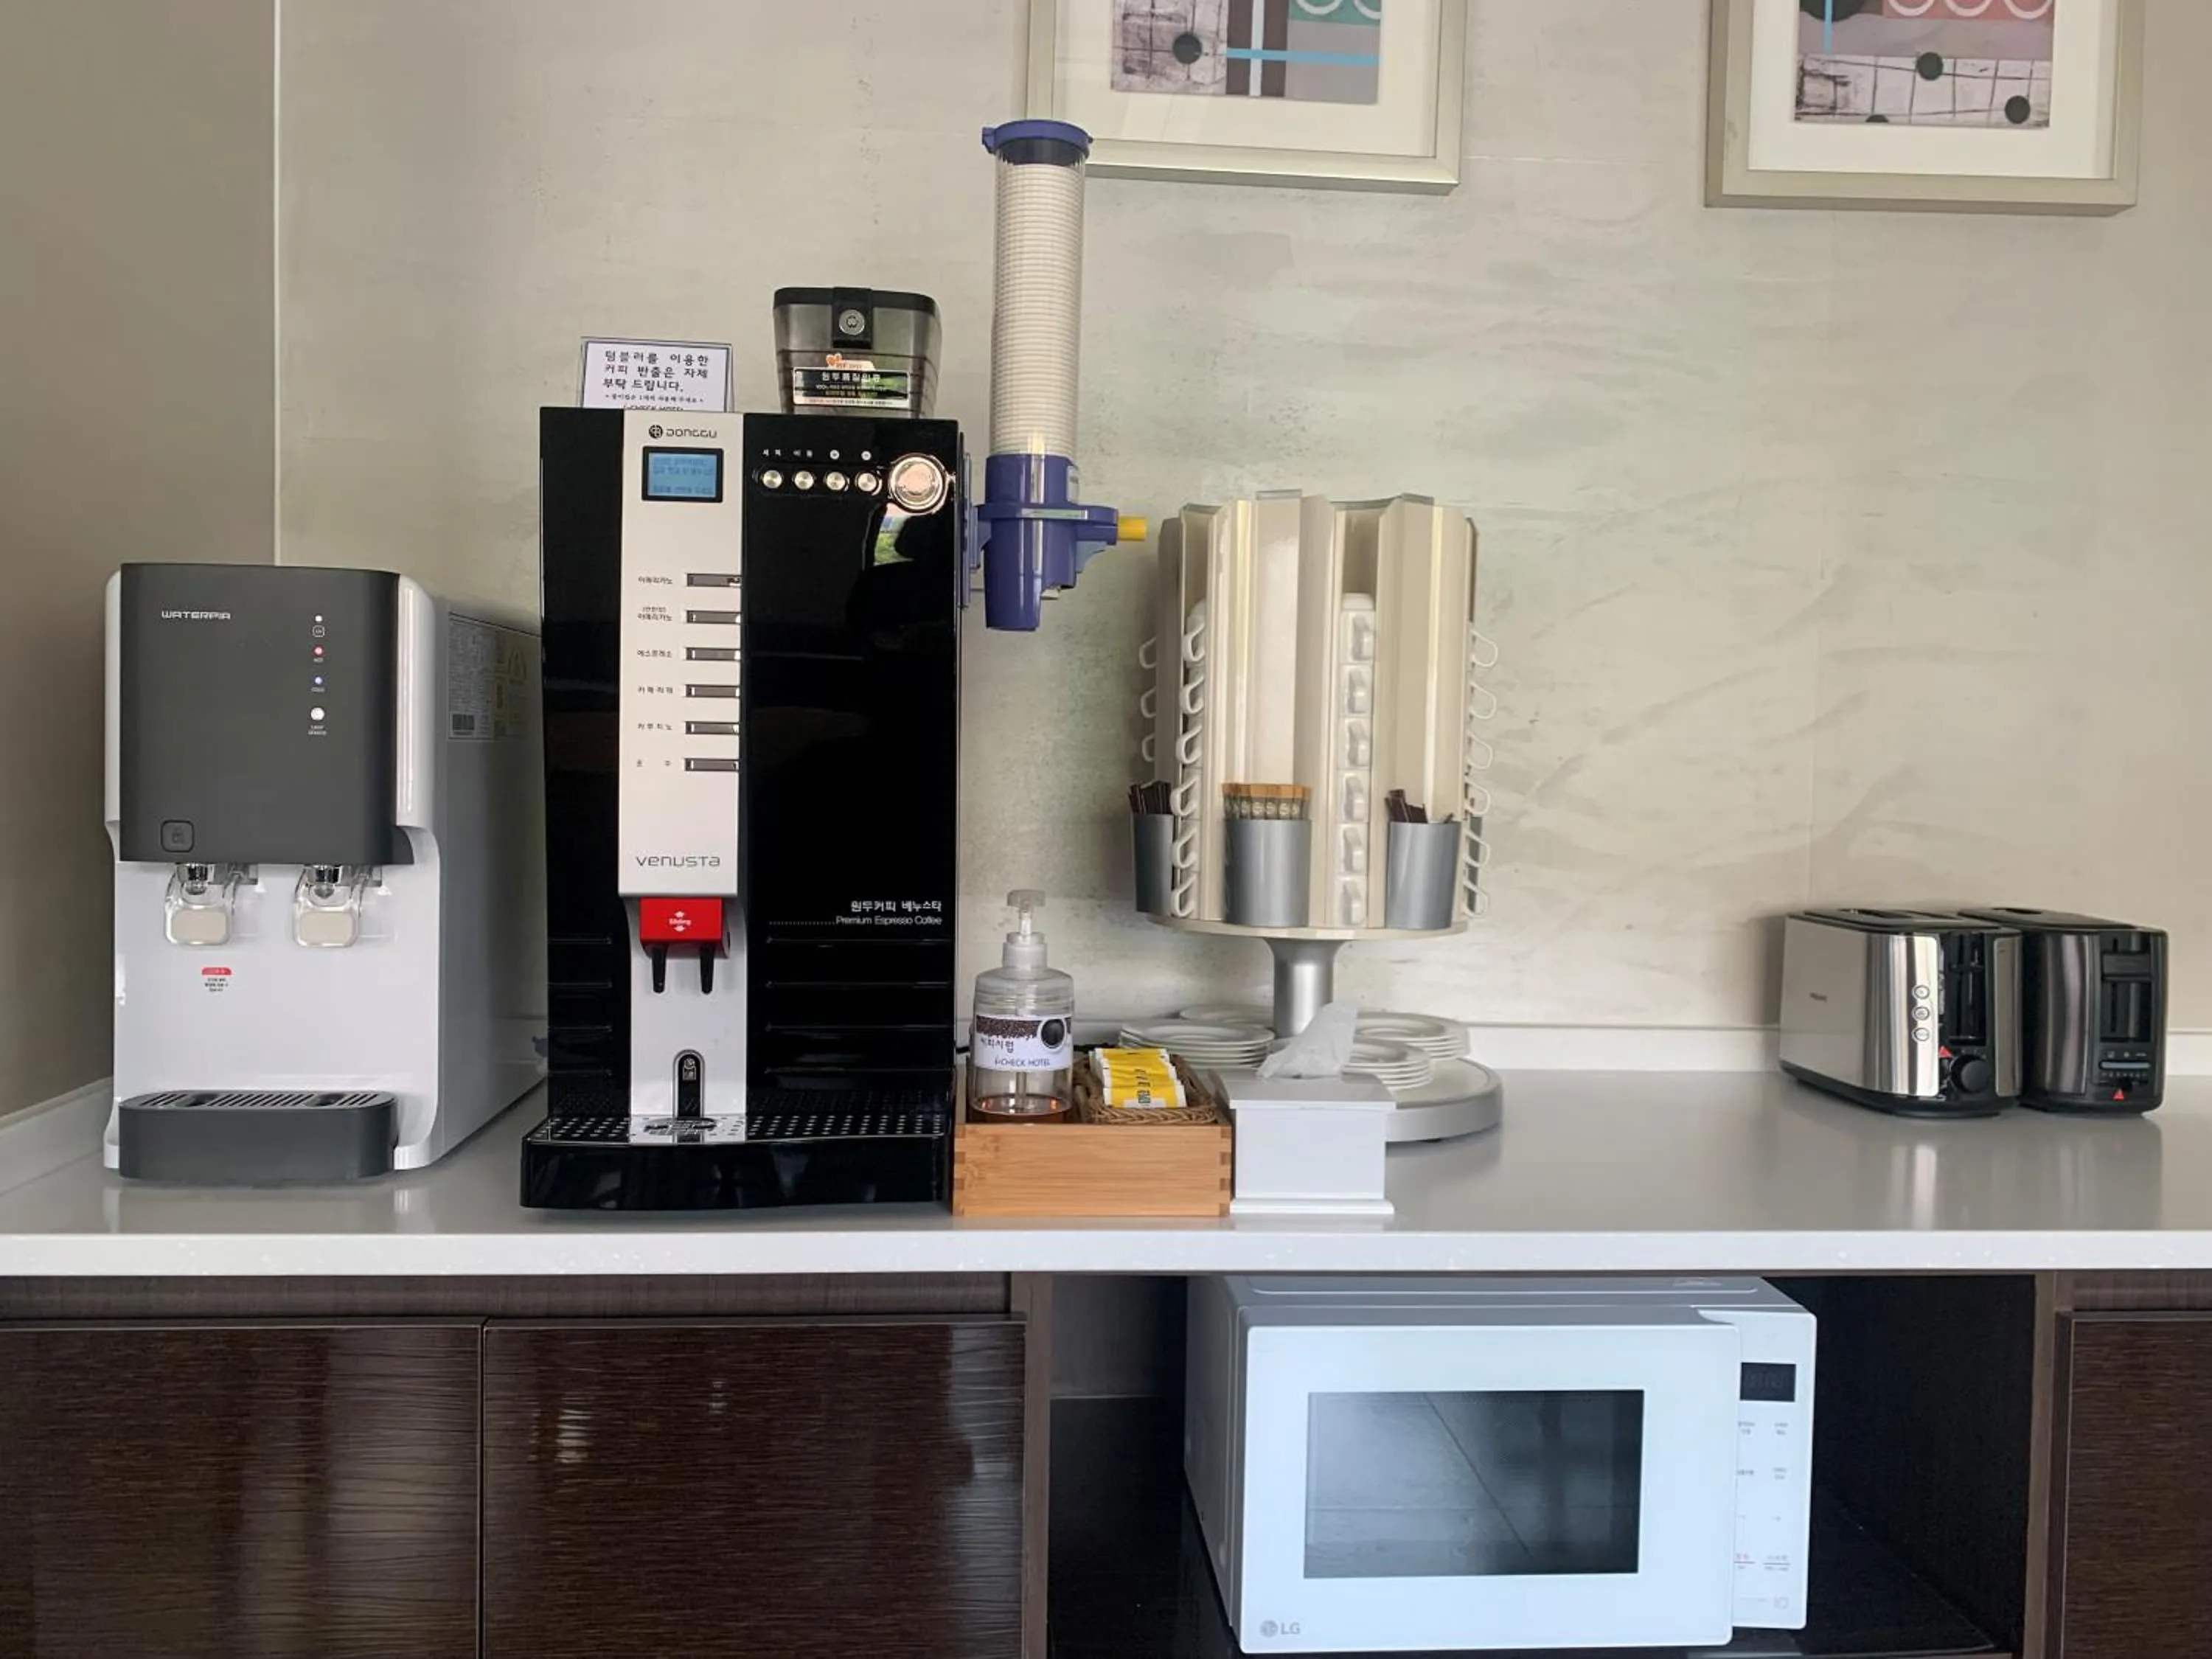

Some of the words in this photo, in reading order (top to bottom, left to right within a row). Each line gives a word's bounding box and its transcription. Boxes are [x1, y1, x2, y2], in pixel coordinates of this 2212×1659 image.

[669, 354, 709, 366] 이용한
[605, 364, 628, 375] 커피
[602, 378, 626, 390] 부탁
[632, 380, 684, 392] 드립니다.
[851, 900, 896, 912] 원두커피
[902, 900, 943, 913] 베누스타
[835, 916, 872, 925] Premium
[874, 915, 914, 926] Espresso
[914, 915, 943, 925] Coffee
[1280, 1622, 1301, 1635] LG
